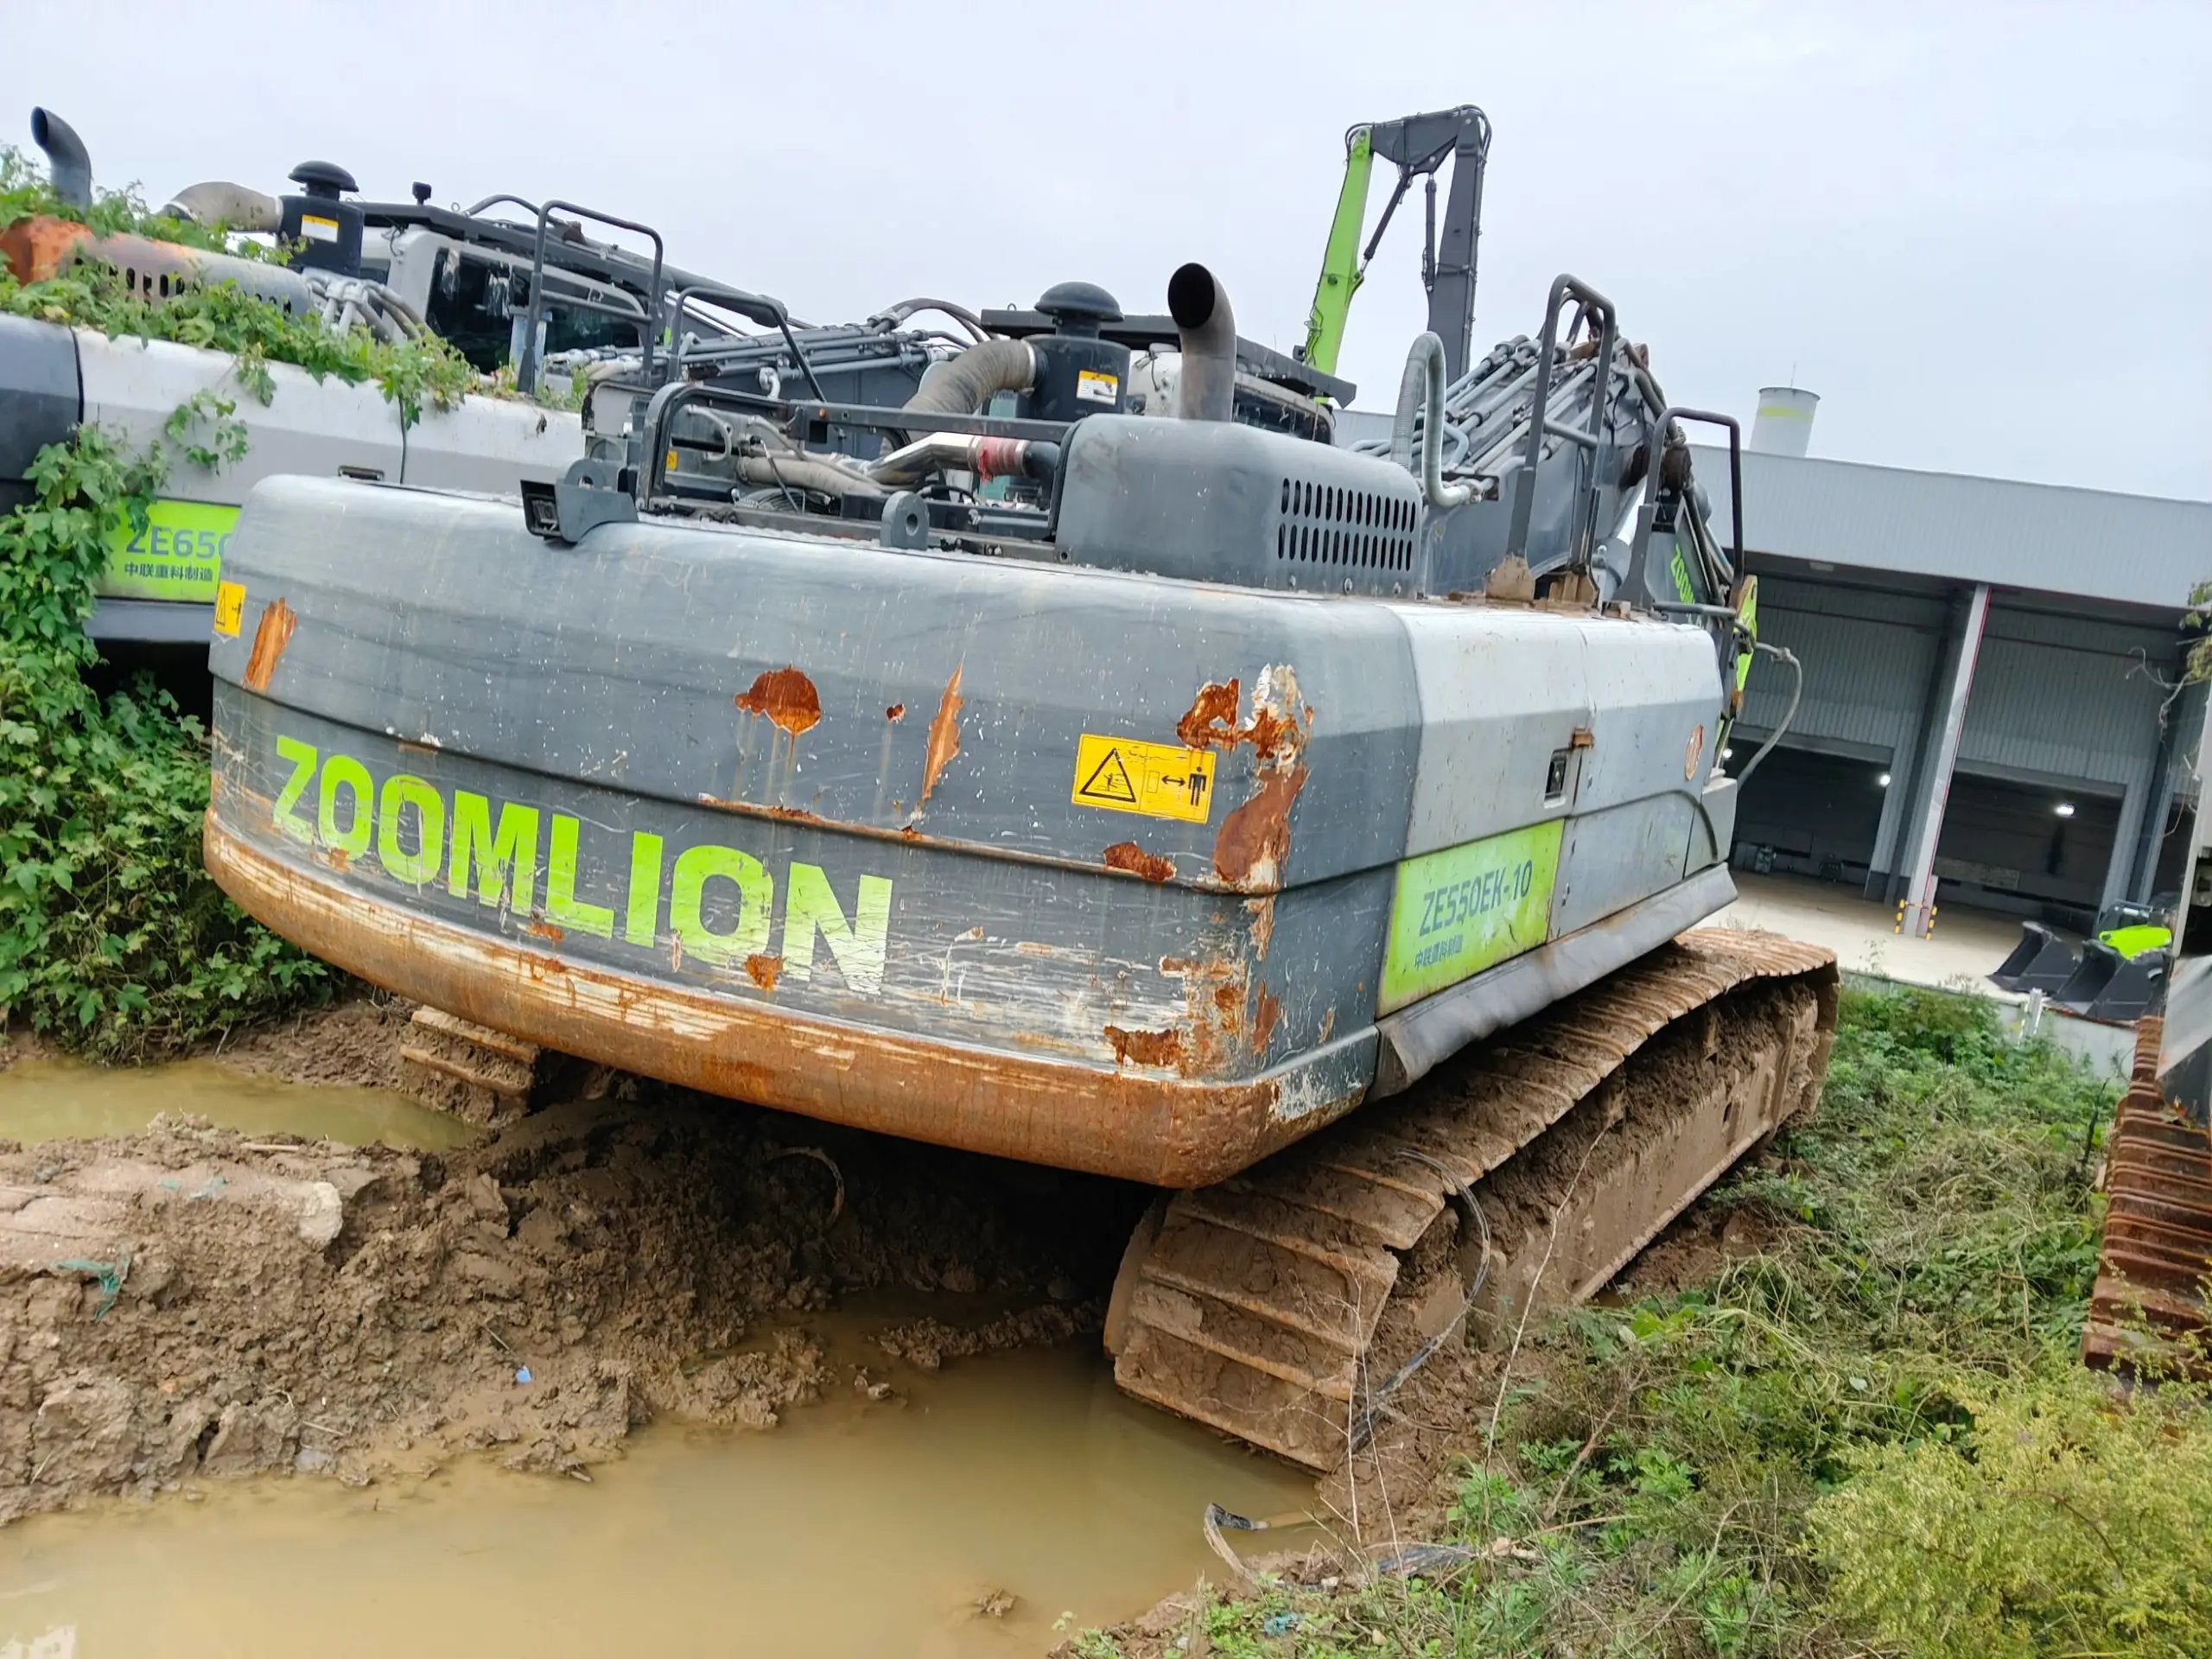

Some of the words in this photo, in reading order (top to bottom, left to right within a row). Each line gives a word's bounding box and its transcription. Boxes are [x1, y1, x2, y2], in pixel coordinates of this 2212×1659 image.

[124, 562, 213, 582] 中联重科制造
[273, 735, 893, 995] ZOOMLION
[1419, 860, 1532, 937] ZE550EK-10
